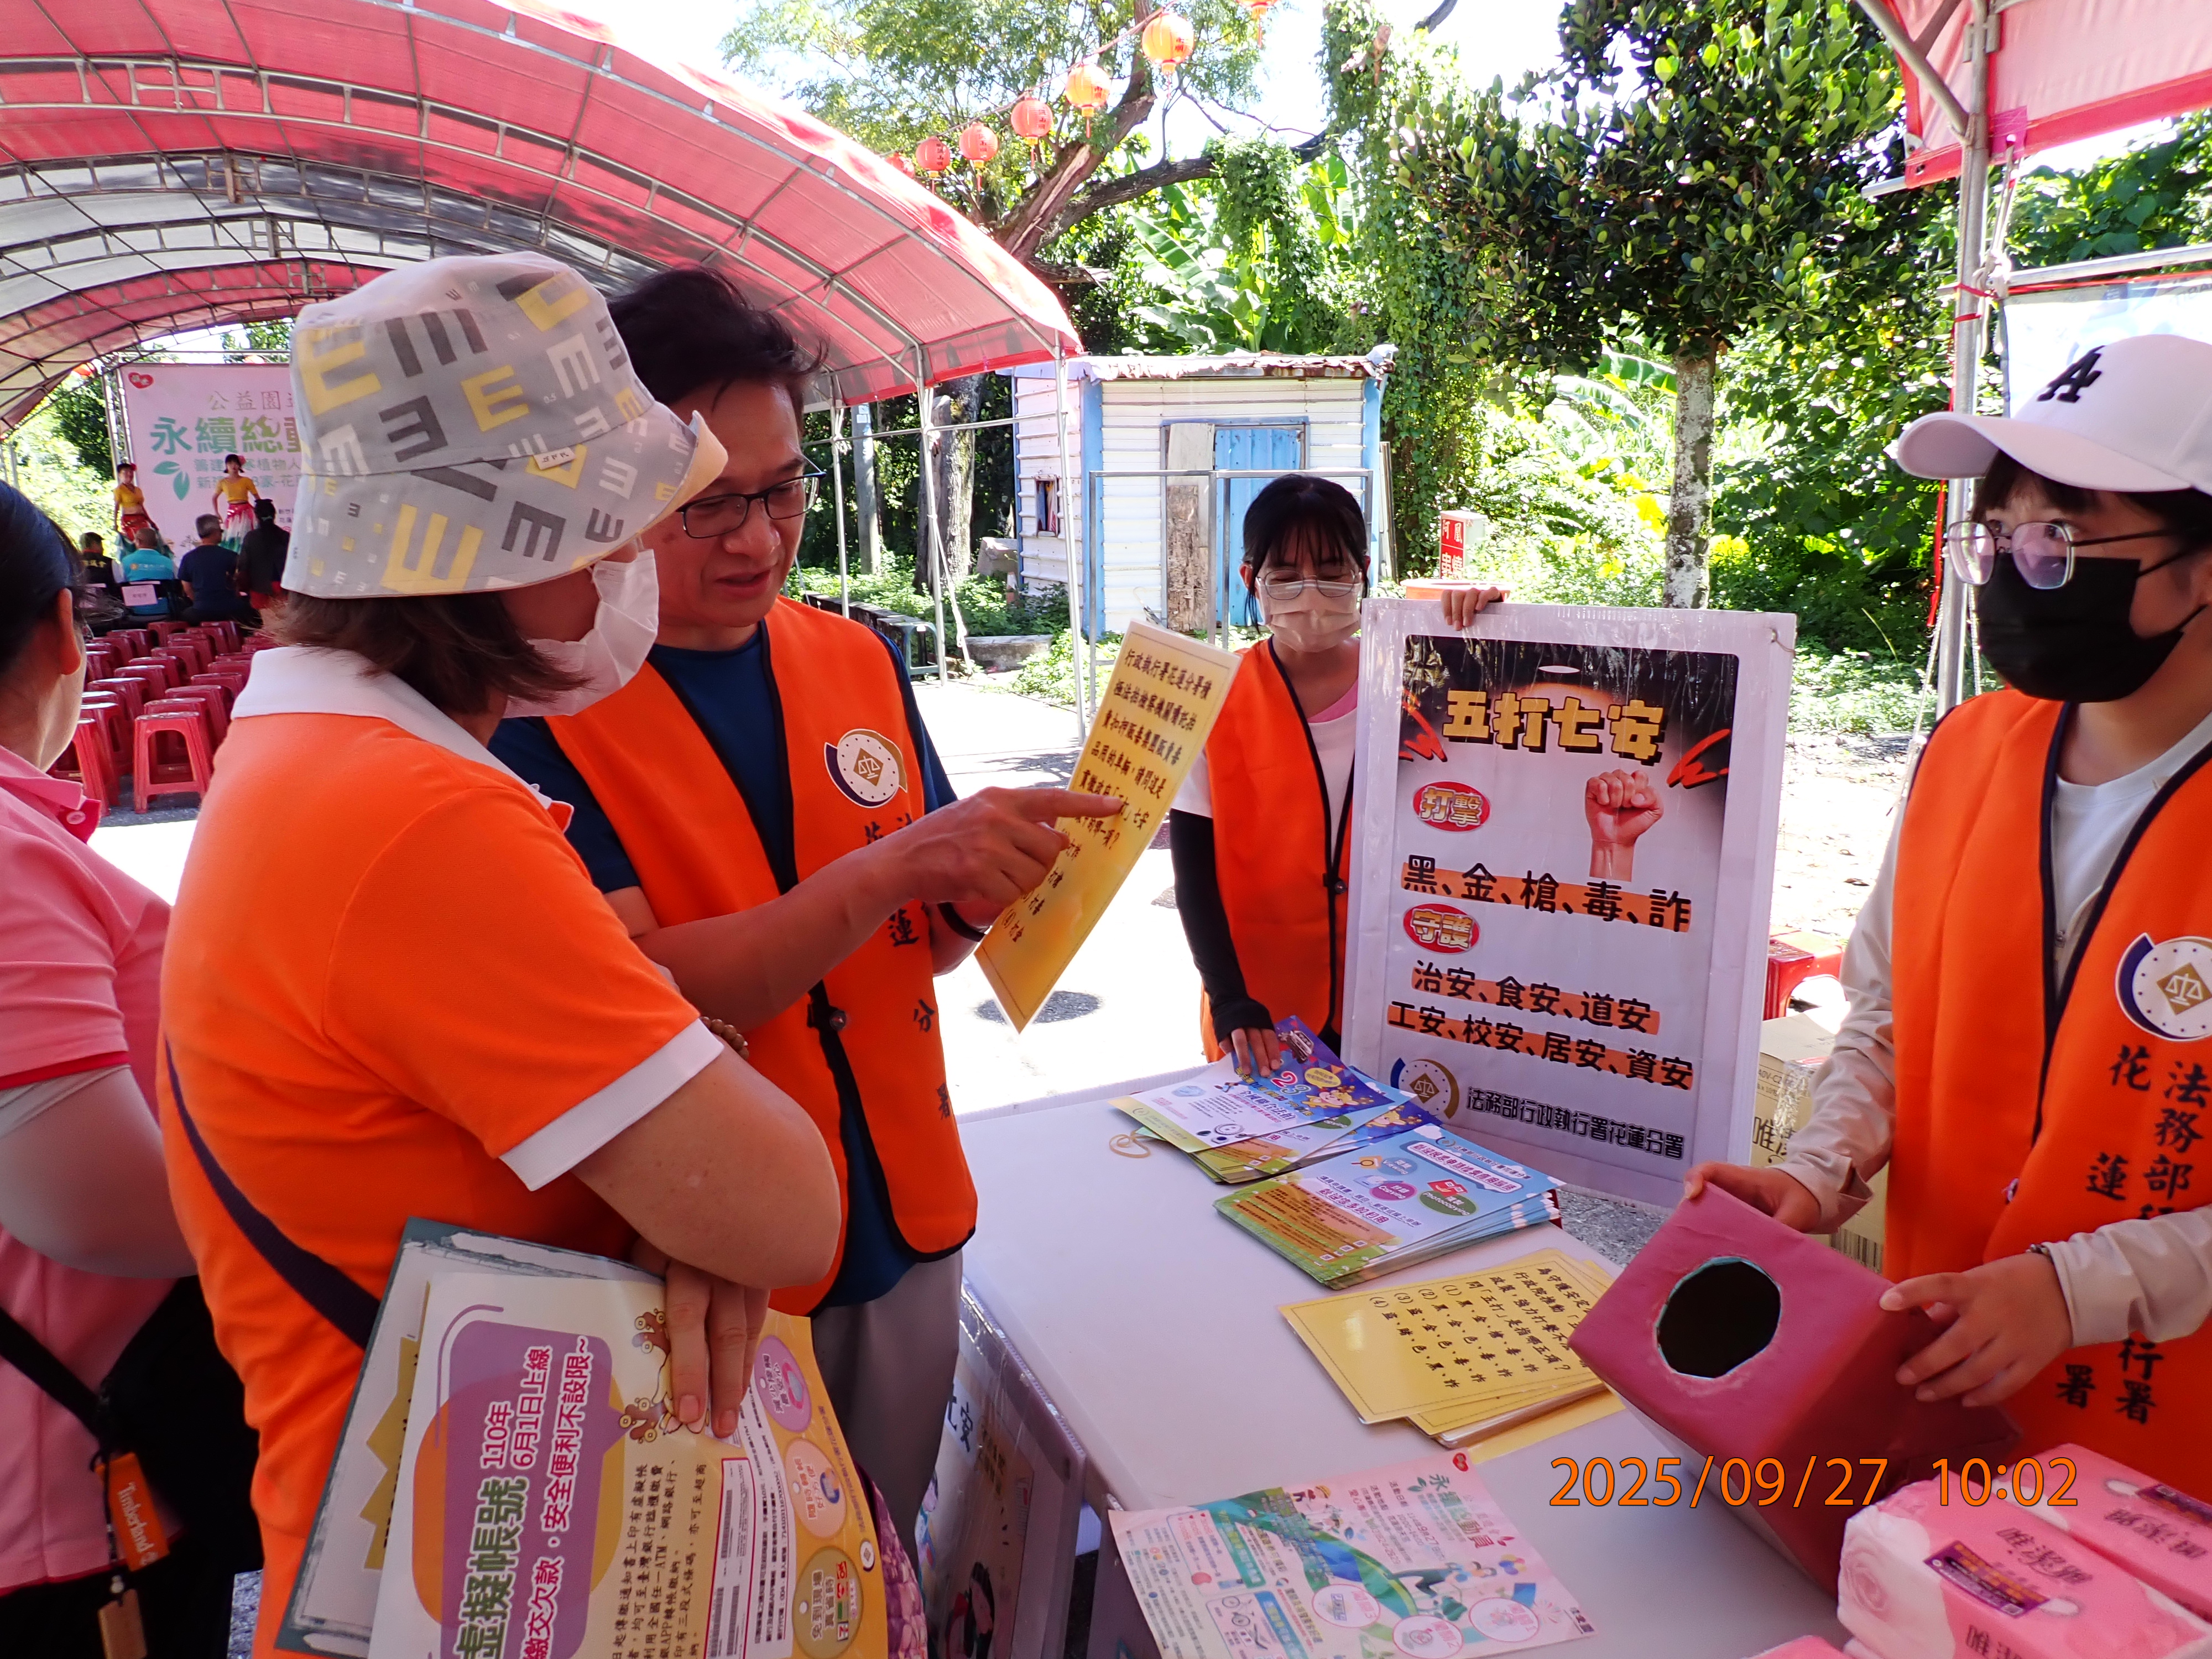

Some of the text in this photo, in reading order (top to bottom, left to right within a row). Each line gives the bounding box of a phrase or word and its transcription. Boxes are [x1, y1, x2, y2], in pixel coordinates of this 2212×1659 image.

[1443, 689, 1665, 766] 五打七安
[1420, 786, 1480, 827] 打擊
[1402, 854, 1692, 933] 黑、金、槍、毒、詐
[1411, 909, 1473, 950] 守護
[1413, 959, 1652, 1034] 治安、食安、道安
[1388, 1000, 1694, 1089] 工安、校安、居安、資安
[1466, 1086, 1685, 1160] 法務部行政執行署花蓮分署
[1382, 1159, 1409, 1175] Viewing
[1378, 1185, 1406, 1199] Copying
[1422, 1191, 1471, 1216] Photocopying
[1369, 1296, 1389, 1308] (4)
[1394, 1292, 1413, 1304] (3)
[1417, 1288, 1438, 1300] (2)
[1442, 1284, 1462, 1296] (1)
[512, 1346, 552, 1469] 6月1日上線
[481, 1402, 514, 1468] 110年
[118, 1481, 155, 1553] Timberland
